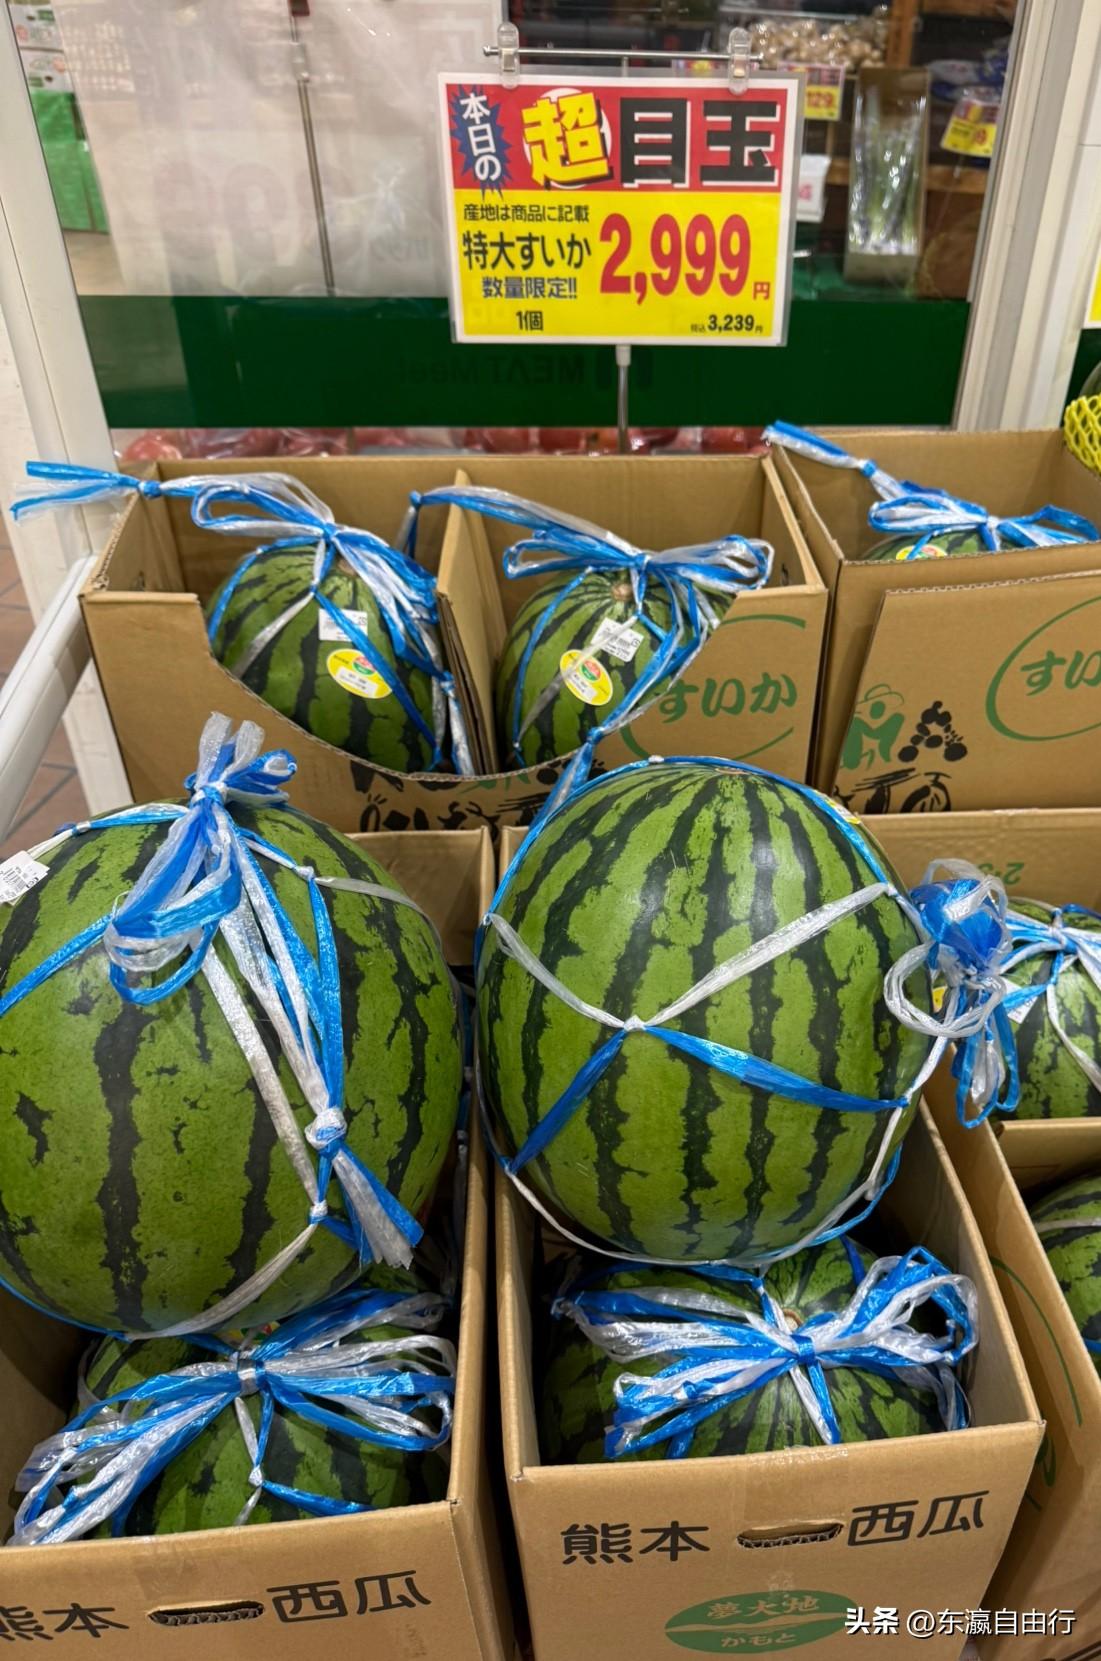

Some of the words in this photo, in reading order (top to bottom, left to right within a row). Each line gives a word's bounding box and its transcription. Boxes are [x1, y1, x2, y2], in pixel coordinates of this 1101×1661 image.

[460, 92, 502, 182] 本日の
[521, 91, 782, 190] 超目玉
[463, 204, 590, 223] 産地は商品に記載
[463, 230, 592, 271] 特大すいか
[515, 311, 544, 332] 1個
[658, 671, 798, 724] すいか
[561, 1522, 709, 1566] 熊本
[847, 1490, 990, 1547] 西瓜
[0, 1602, 130, 1640] 熊本
[266, 1569, 432, 1624] 西瓜
[706, 1595, 821, 1619] 夢大地
[721, 1632, 797, 1648] かもと
